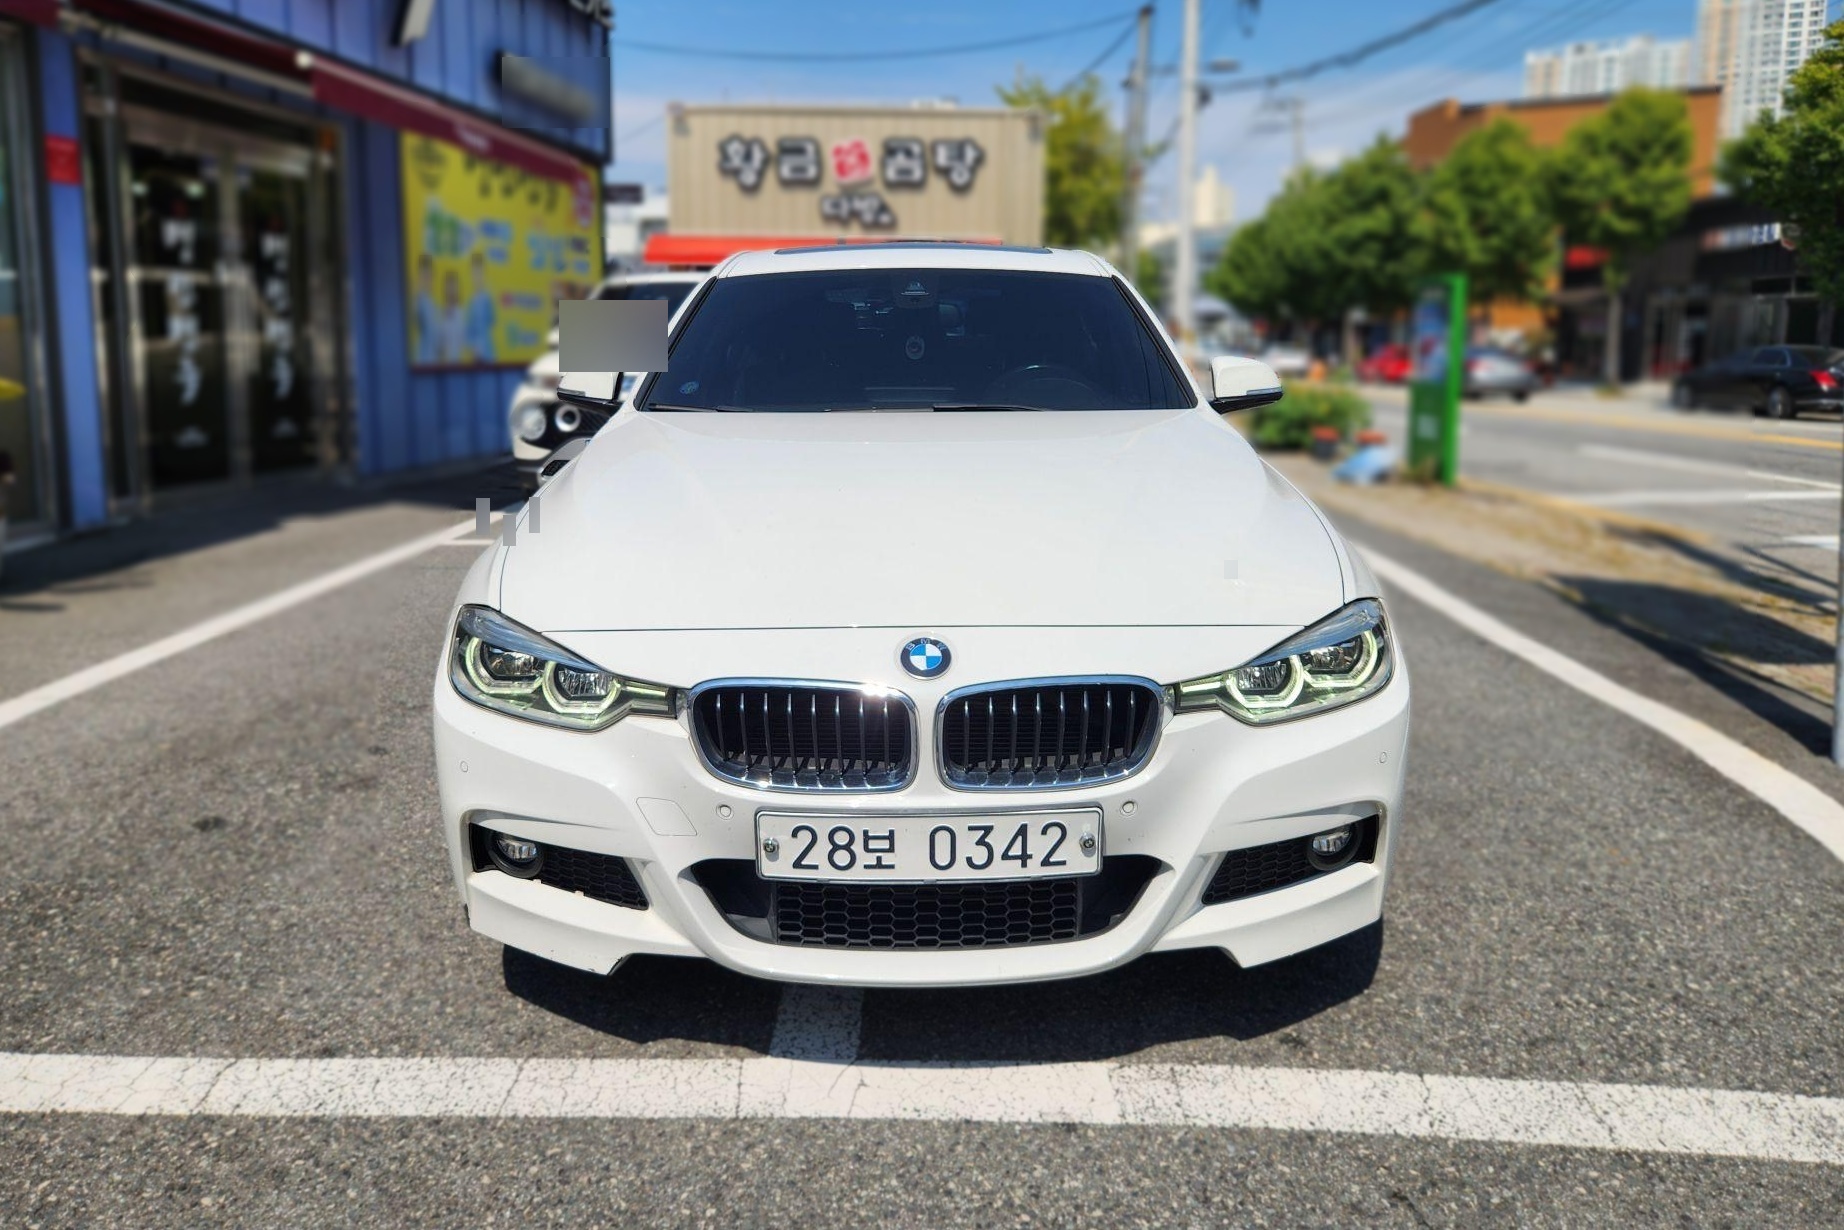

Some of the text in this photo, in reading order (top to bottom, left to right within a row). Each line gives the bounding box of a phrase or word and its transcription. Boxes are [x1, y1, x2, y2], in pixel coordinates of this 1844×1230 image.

[718, 135, 821, 191] 황금
[882, 137, 983, 191] 곰탕
[791, 821, 1068, 871] 28보 0342
